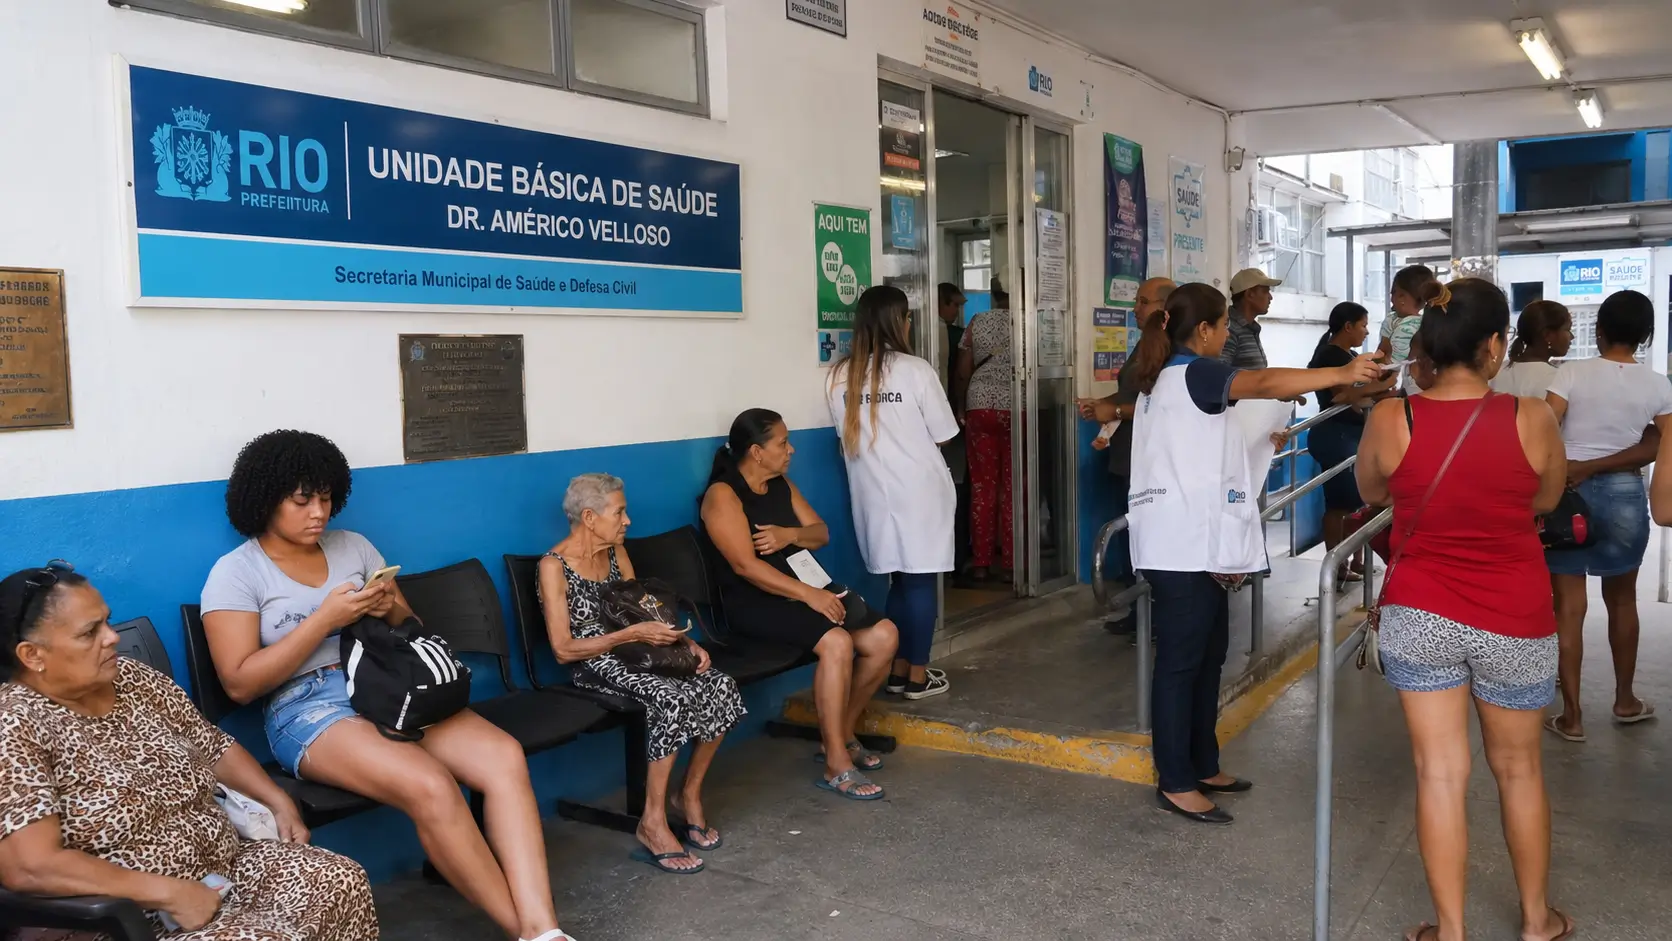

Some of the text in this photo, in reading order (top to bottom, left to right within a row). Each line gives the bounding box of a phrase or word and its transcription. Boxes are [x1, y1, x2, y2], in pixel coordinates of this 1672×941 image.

[239, 129, 328, 193] RIO
[368, 146, 718, 217] UNIDADE BÁSICA DE SAÚDE
[447, 204, 671, 247] DR. AMÉRICO VELLOSO
[818, 213, 867, 234] AQUI TEM
[335, 265, 637, 295] Secretaria Municipal de Saúde e Defesa Civil
[1580, 267, 1600, 277] RIO
